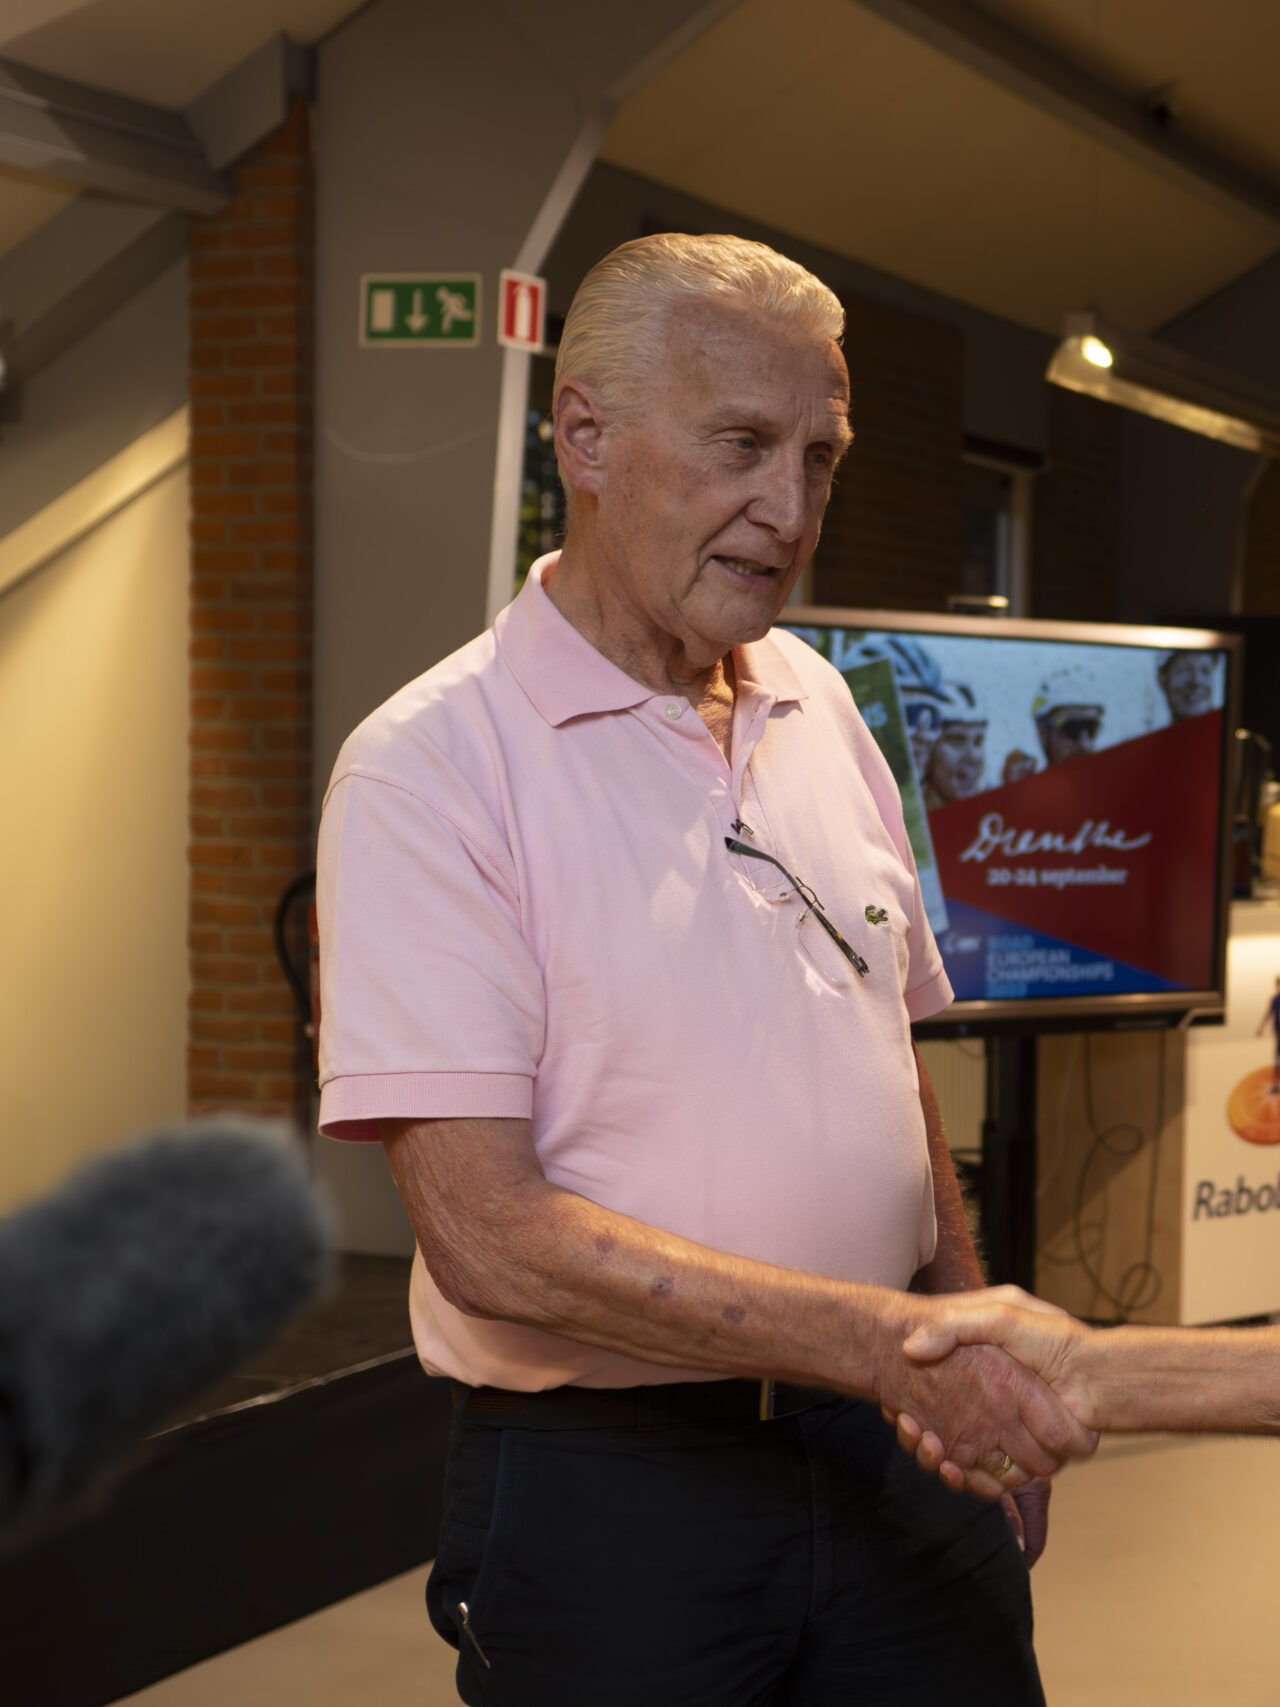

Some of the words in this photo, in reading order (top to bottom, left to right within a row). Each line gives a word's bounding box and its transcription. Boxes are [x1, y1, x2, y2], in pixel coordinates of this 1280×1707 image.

[961, 813, 1152, 862] Drenthe
[1040, 865, 1127, 889] september
[987, 950, 1071, 967] EUROPEAN
[986, 963, 1114, 983] CHAMPIONSHIPS
